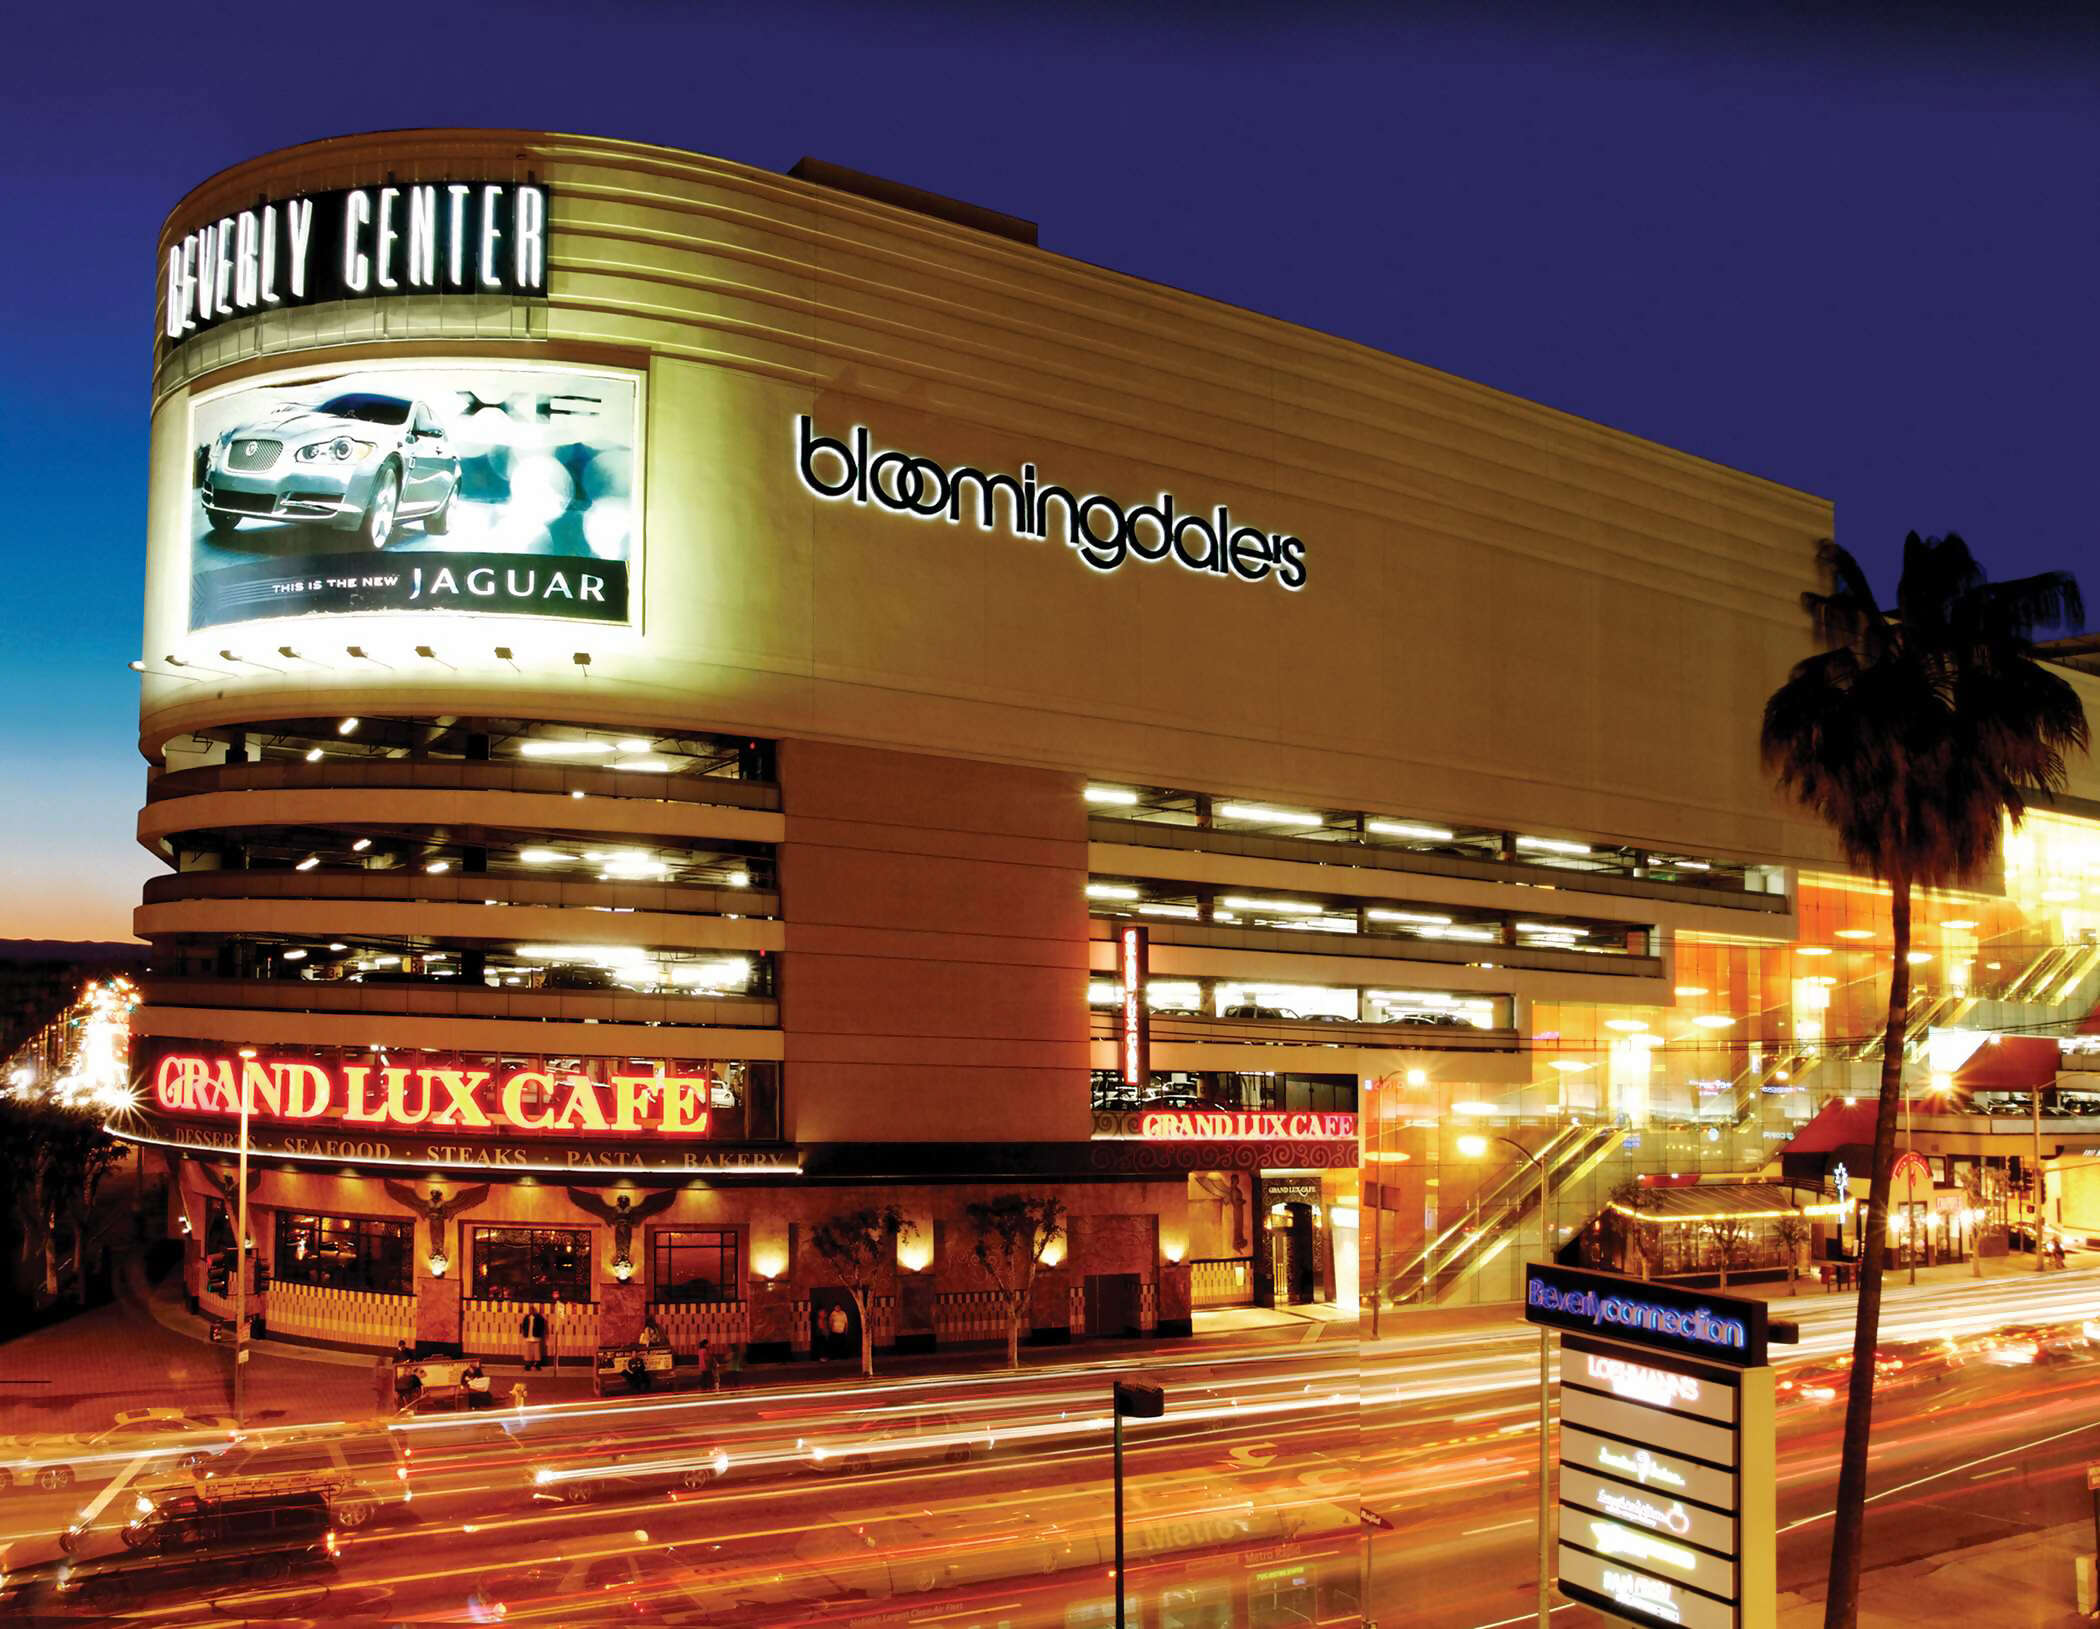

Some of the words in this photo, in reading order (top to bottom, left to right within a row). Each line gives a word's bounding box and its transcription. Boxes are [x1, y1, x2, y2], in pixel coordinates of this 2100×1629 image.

[166, 197, 313, 339] BEVERLY
[343, 184, 543, 292] CENTER
[797, 414, 1307, 590] bloomingdale's
[272, 582, 305, 594] THIS
[308, 579, 323, 591] IS
[326, 577, 358, 589] THE
[361, 574, 401, 587] NEW
[409, 566, 606, 602] JAGUAR
[156, 1055, 333, 1118] GRAND
[342, 1065, 493, 1129] LUX
[502, 1073, 711, 1134] CAFE
[1142, 1113, 1234, 1138] GRAND
[1236, 1114, 1288, 1138] LUX
[1289, 1114, 1354, 1138] CAFE
[283, 1137, 391, 1160] SEAFOOD
[426, 1146, 527, 1167] STEAKS
[567, 1150, 645, 1169] PASTA
[683, 1152, 784, 1170] BAKERY
[1145, 1516, 1236, 1549] Metro
